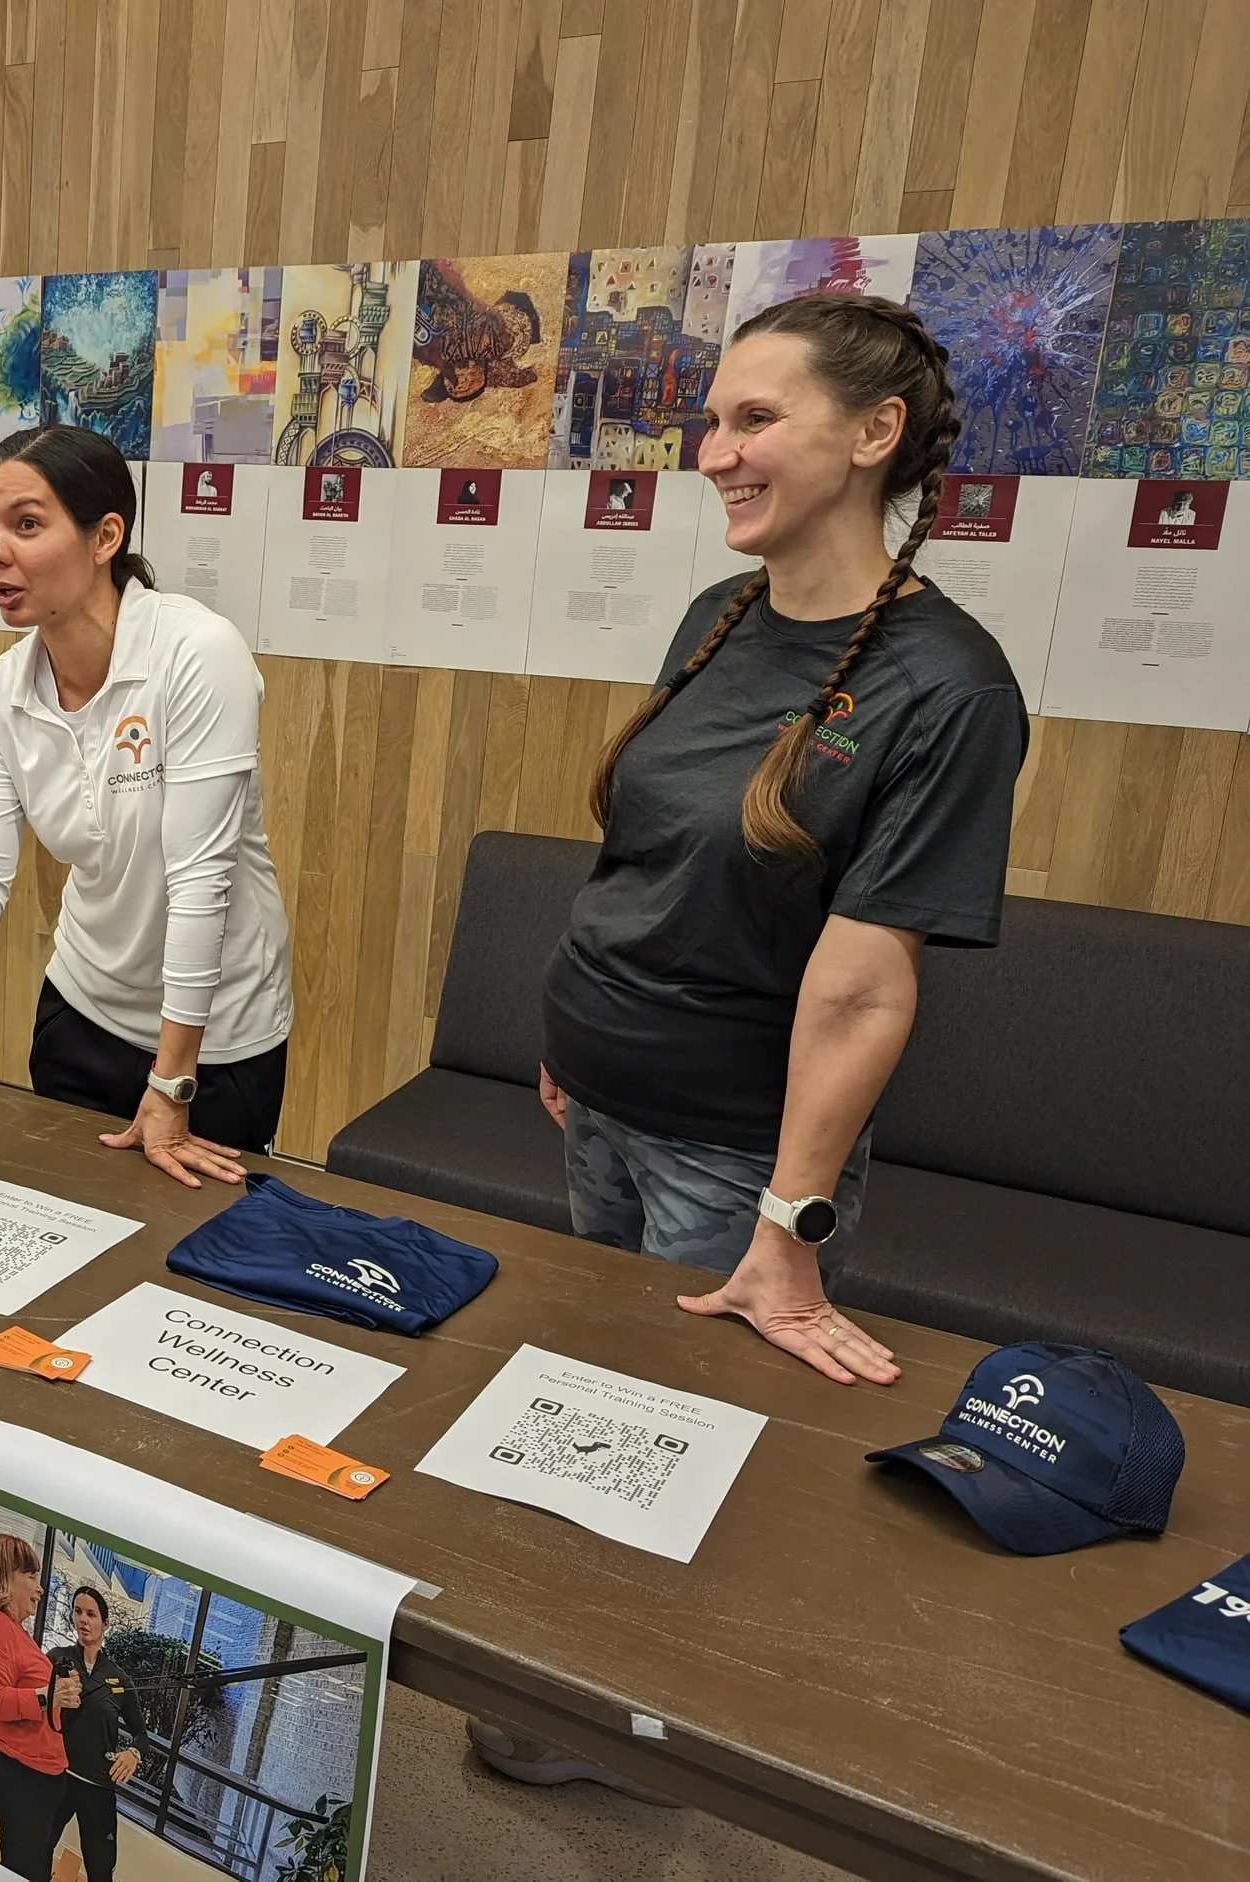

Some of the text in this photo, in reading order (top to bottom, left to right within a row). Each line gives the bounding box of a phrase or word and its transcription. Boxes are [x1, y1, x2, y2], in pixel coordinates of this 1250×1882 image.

[816, 743, 853, 765] CENTER
[21, 1206, 57, 1221] Training
[58, 1218, 97, 1233] Session
[36, 1203, 53, 1214] Win
[63, 1212, 94, 1224] FREE
[305, 1269, 402, 1312] WELLNESS CENTER
[310, 1263, 406, 1310] CONNECTION
[157, 1330, 295, 1388] Wellness
[165, 1309, 336, 1375] Connection
[148, 1356, 257, 1401] Center
[539, 1373, 716, 1430] Personal Training Session
[561, 1371, 598, 1385] Enter
[601, 1381, 613, 1389] to
[618, 1386, 643, 1398] Win
[659, 1398, 703, 1416] FREE
[958, 1411, 1004, 1435] WELLNESS
[1006, 1432, 1058, 1464] CENTER
[965, 1397, 1066, 1454] CONNECTION
